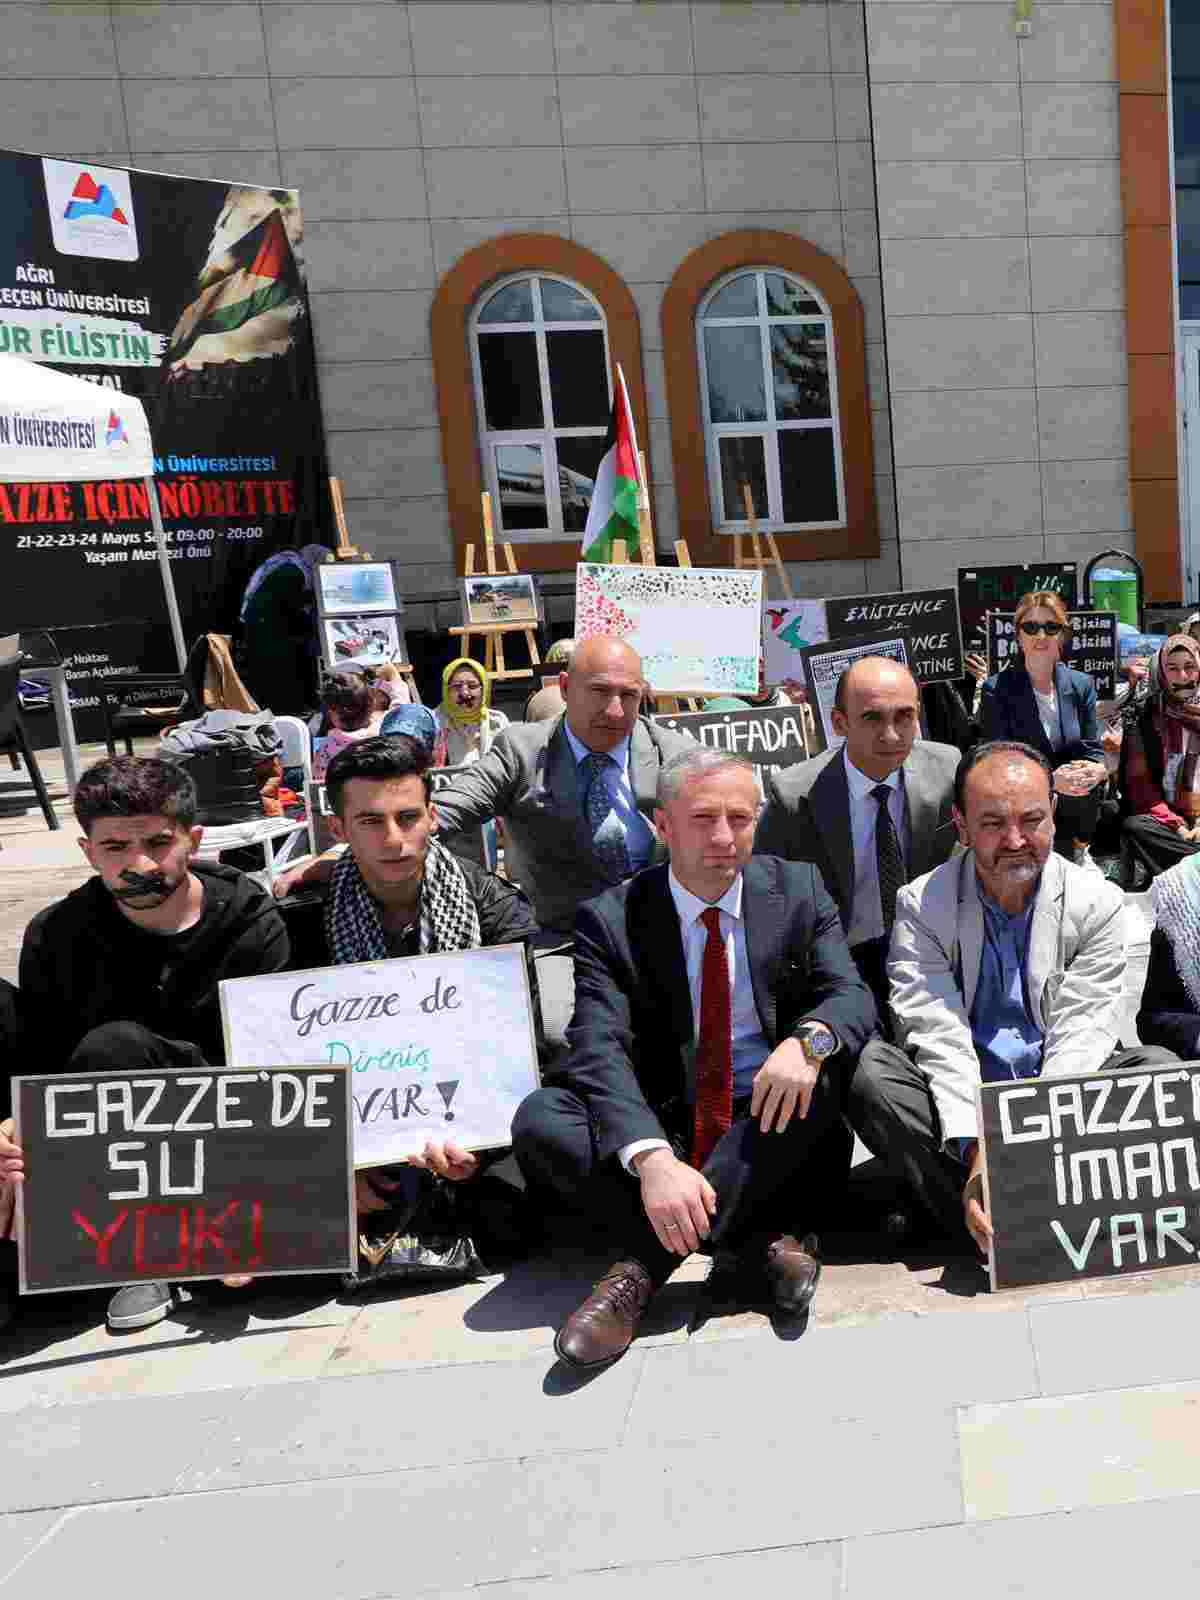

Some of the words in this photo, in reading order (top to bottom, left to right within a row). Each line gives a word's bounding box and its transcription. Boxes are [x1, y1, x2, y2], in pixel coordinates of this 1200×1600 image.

[16, 263, 55, 284] AĞRI
[0, 287, 43, 307] EÇEN
[46, 288, 151, 315] ÜNİVERSİTESİ
[40, 322, 152, 360] FİLİSTİN
[16, 533, 98, 549] 21-22-23-24
[131, 548, 184, 563] Merezi
[289, 983, 400, 1036] Gazze
[418, 976, 462, 1013] de
[45, 1071, 335, 1138] GAZZE'DE
[108, 1139, 204, 1200] SU
[71, 1200, 262, 1271] YOK!
